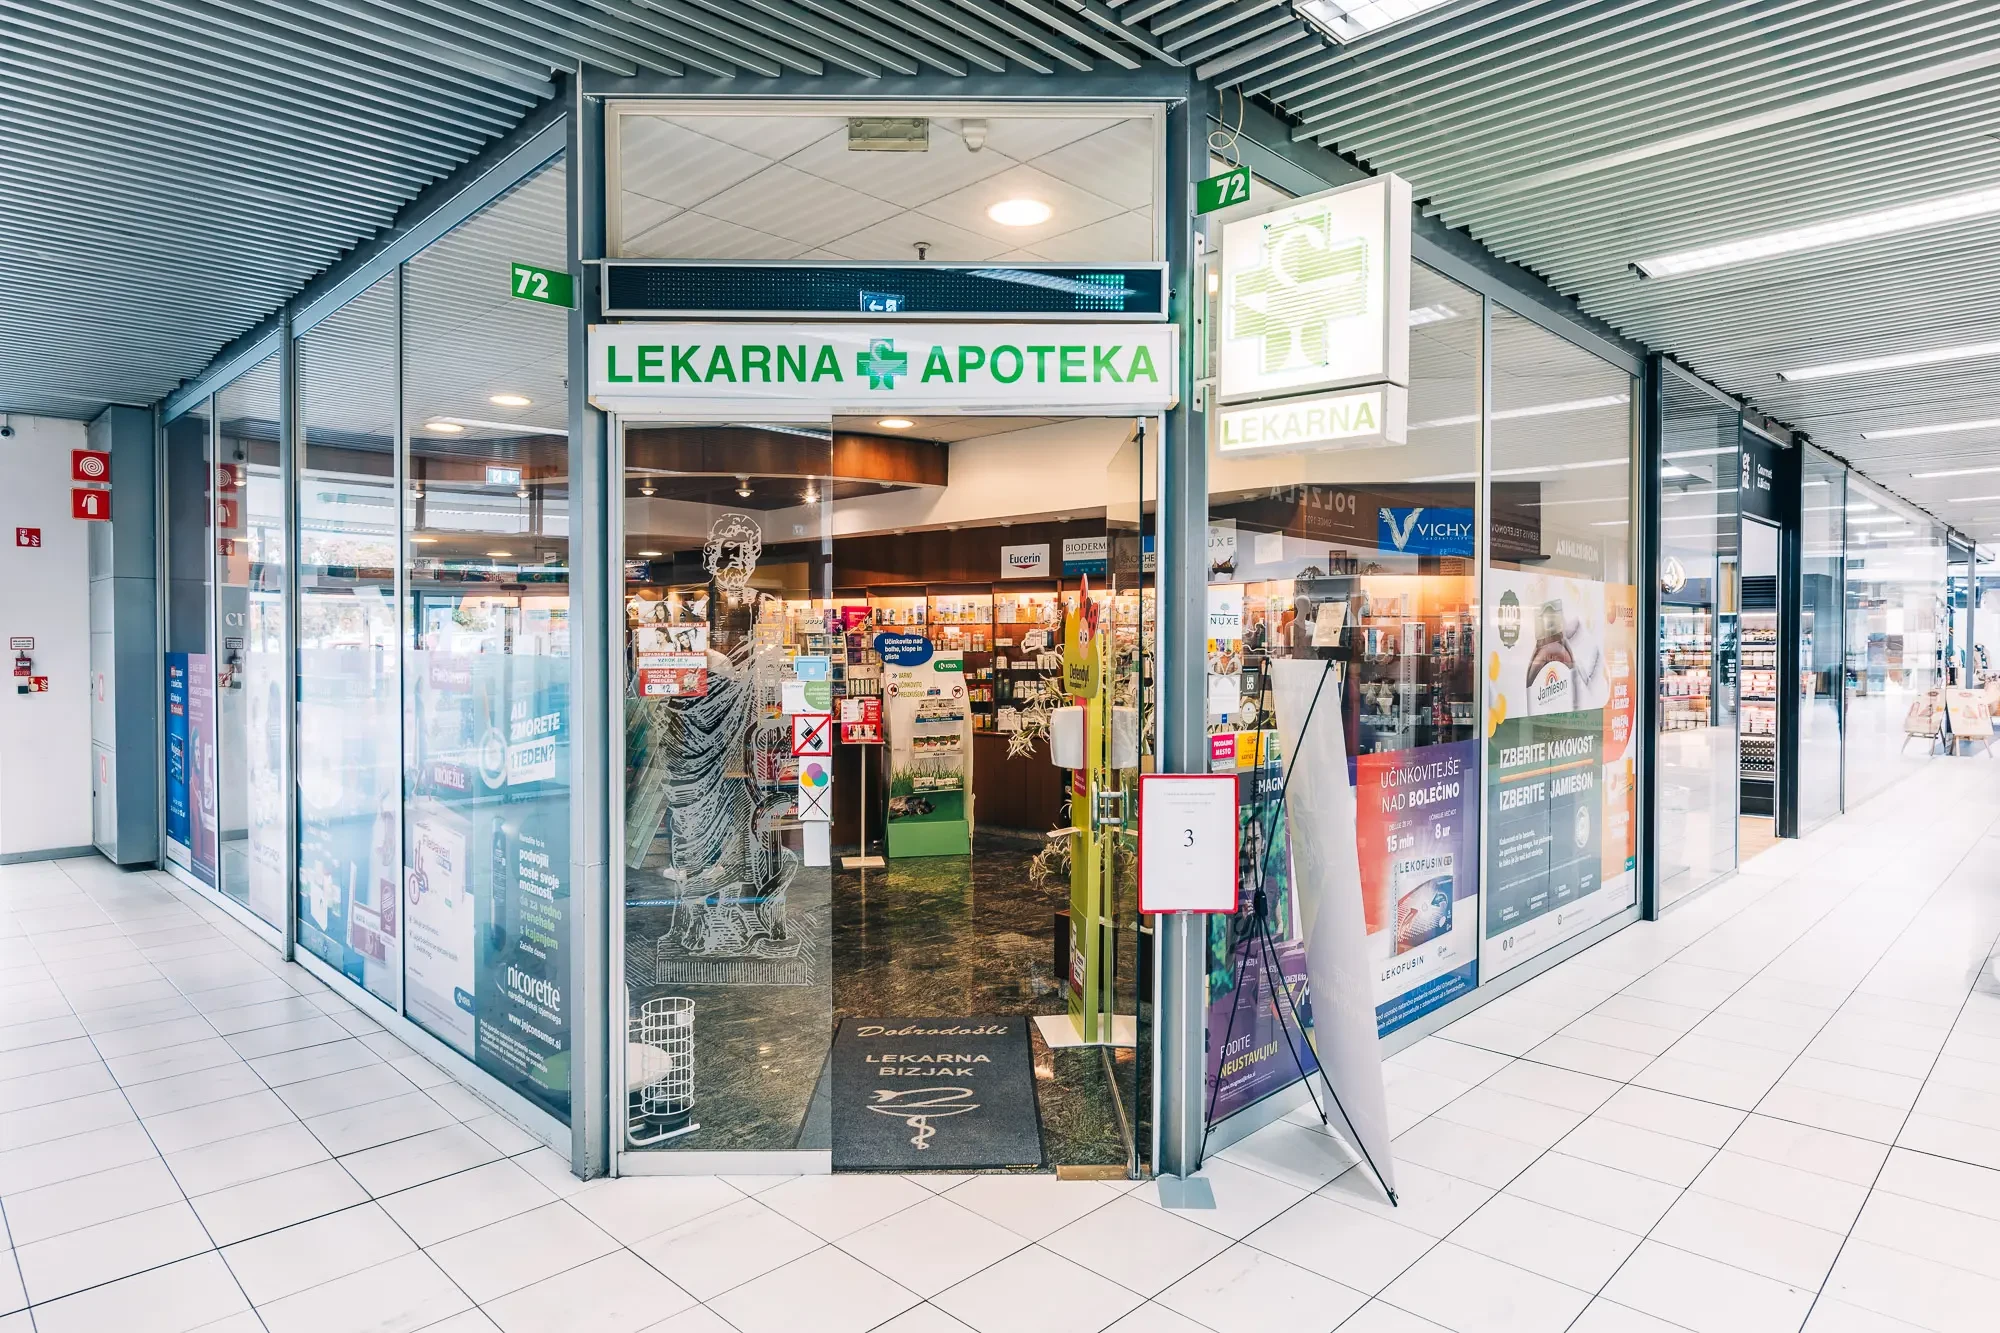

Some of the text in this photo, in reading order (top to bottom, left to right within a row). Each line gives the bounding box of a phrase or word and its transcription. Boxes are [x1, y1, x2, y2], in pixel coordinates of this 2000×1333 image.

[1216, 173, 1246, 205] 72
[514, 268, 549, 299] 72
[608, 345, 1159, 384] LEKARNA APOTEKA
[1223, 401, 1376, 446] LEKARNA
[1417, 523, 1472, 537] VICHY
[1009, 553, 1041, 564] Eucerin
[1210, 617, 1239, 626] NUXE
[1537, 677, 1568, 701] Jamieson
[516, 744, 555, 768] TEDEN?
[1500, 735, 1594, 769] IZBERITE KAKOVOST
[1380, 757, 1460, 789] UČINKOVITEJŠE
[1382, 782, 1460, 813] NAD BOLEČINO
[1499, 772, 1593, 811] IZBERITE JAMIESON
[1183, 829, 1194, 848] 3
[1435, 823, 1451, 839] 8 ur
[1386, 834, 1414, 853] 15 min
[519, 849, 549, 868] podvojili
[1399, 856, 1443, 874] LEKOFUSIN
[519, 863, 560, 889] boste svoje
[519, 879, 554, 903] možnosti,
[525, 924, 559, 950] kajenjem
[1381, 955, 1424, 982] LEKOFUSIN
[507, 964, 561, 1012] nicorette
[857, 1024, 1009, 1037] Dobrodošli
[865, 1054, 991, 1063] LEKARNA
[1220, 1040, 1278, 1079] NEUSTAVLJIVI
[878, 1067, 975, 1077] BIZJAK
